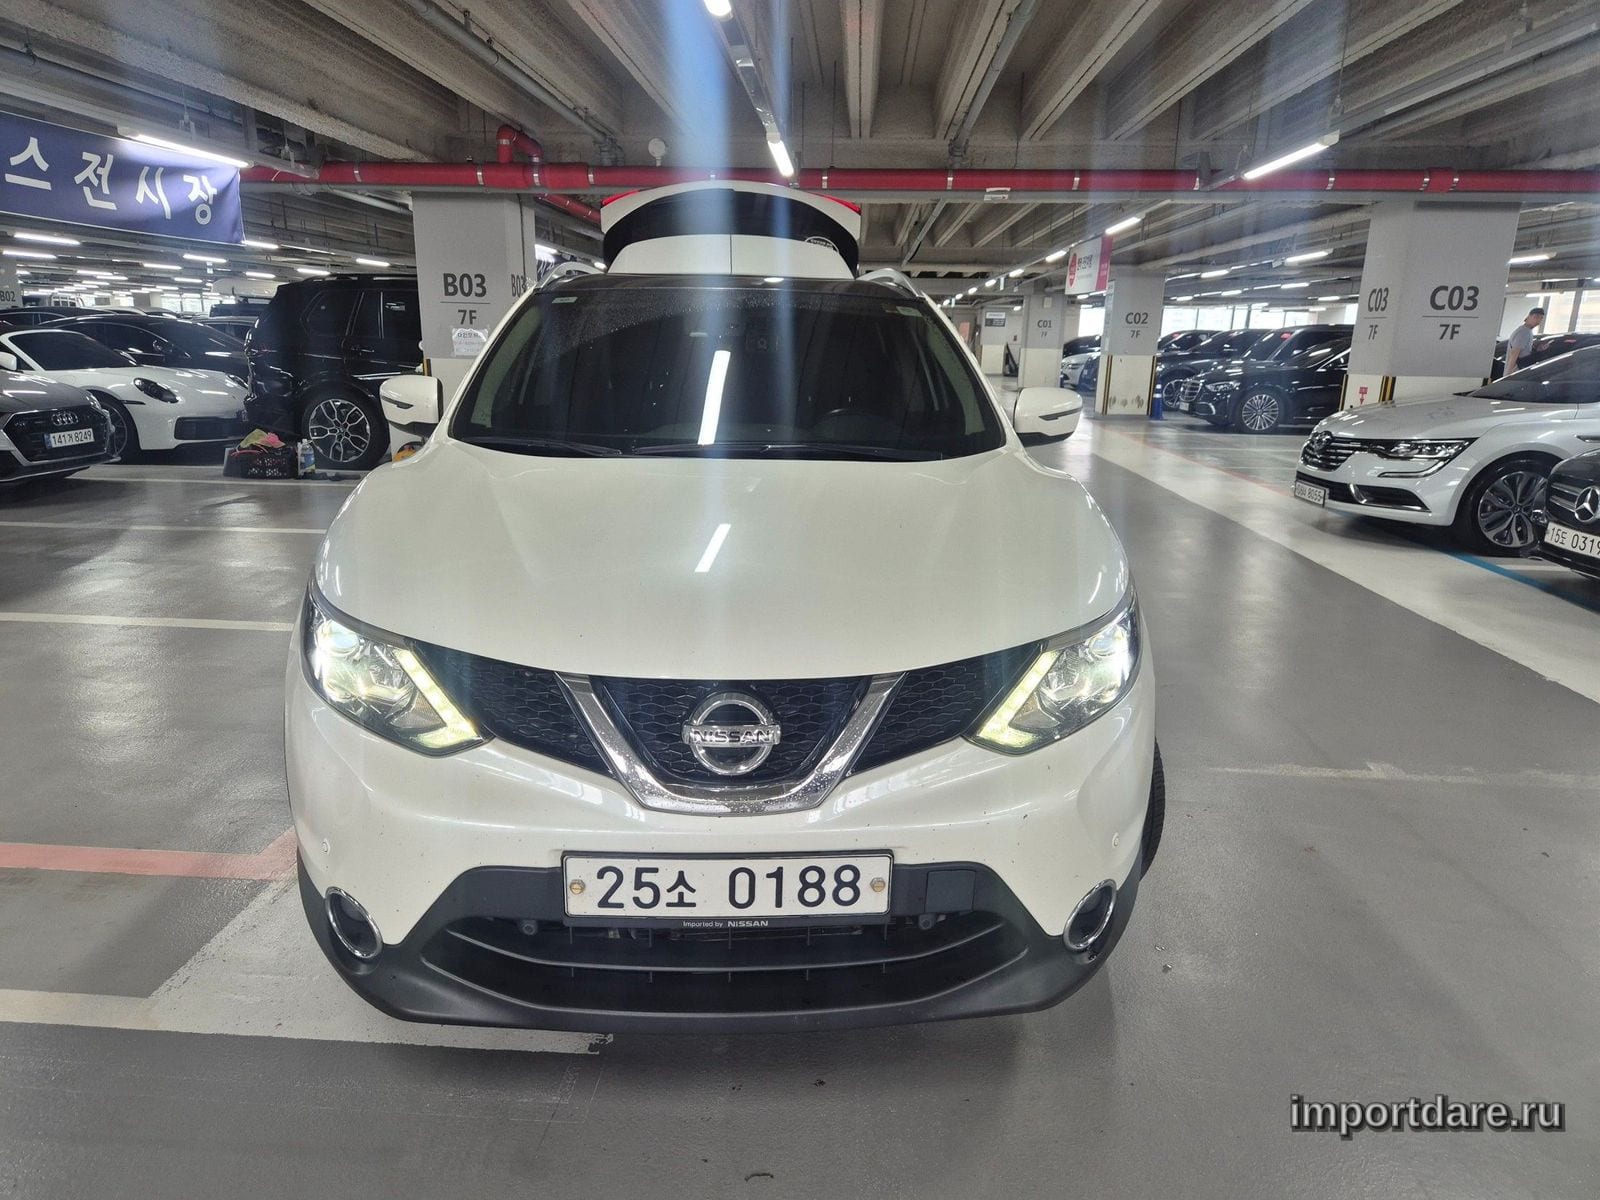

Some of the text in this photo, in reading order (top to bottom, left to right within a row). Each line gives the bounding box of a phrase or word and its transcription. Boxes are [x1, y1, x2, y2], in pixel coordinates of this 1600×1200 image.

[443, 273, 487, 298] B03
[1367, 287, 1389, 312] C03
[1429, 285, 1480, 311] C03
[457, 309, 478, 325] 7F
[1037, 319, 1053, 329] C01
[1125, 312, 1149, 325] C02
[1130, 329, 1141, 339] 7F
[1368, 324, 1379, 340] 7F
[1439, 324, 1461, 340] 7F
[1550, 527, 1568, 546] 15도
[692, 729, 772, 744] NISSAN
[596, 864, 861, 909] 25소 0188
[683, 920, 769, 928] Imported by NISSAN
